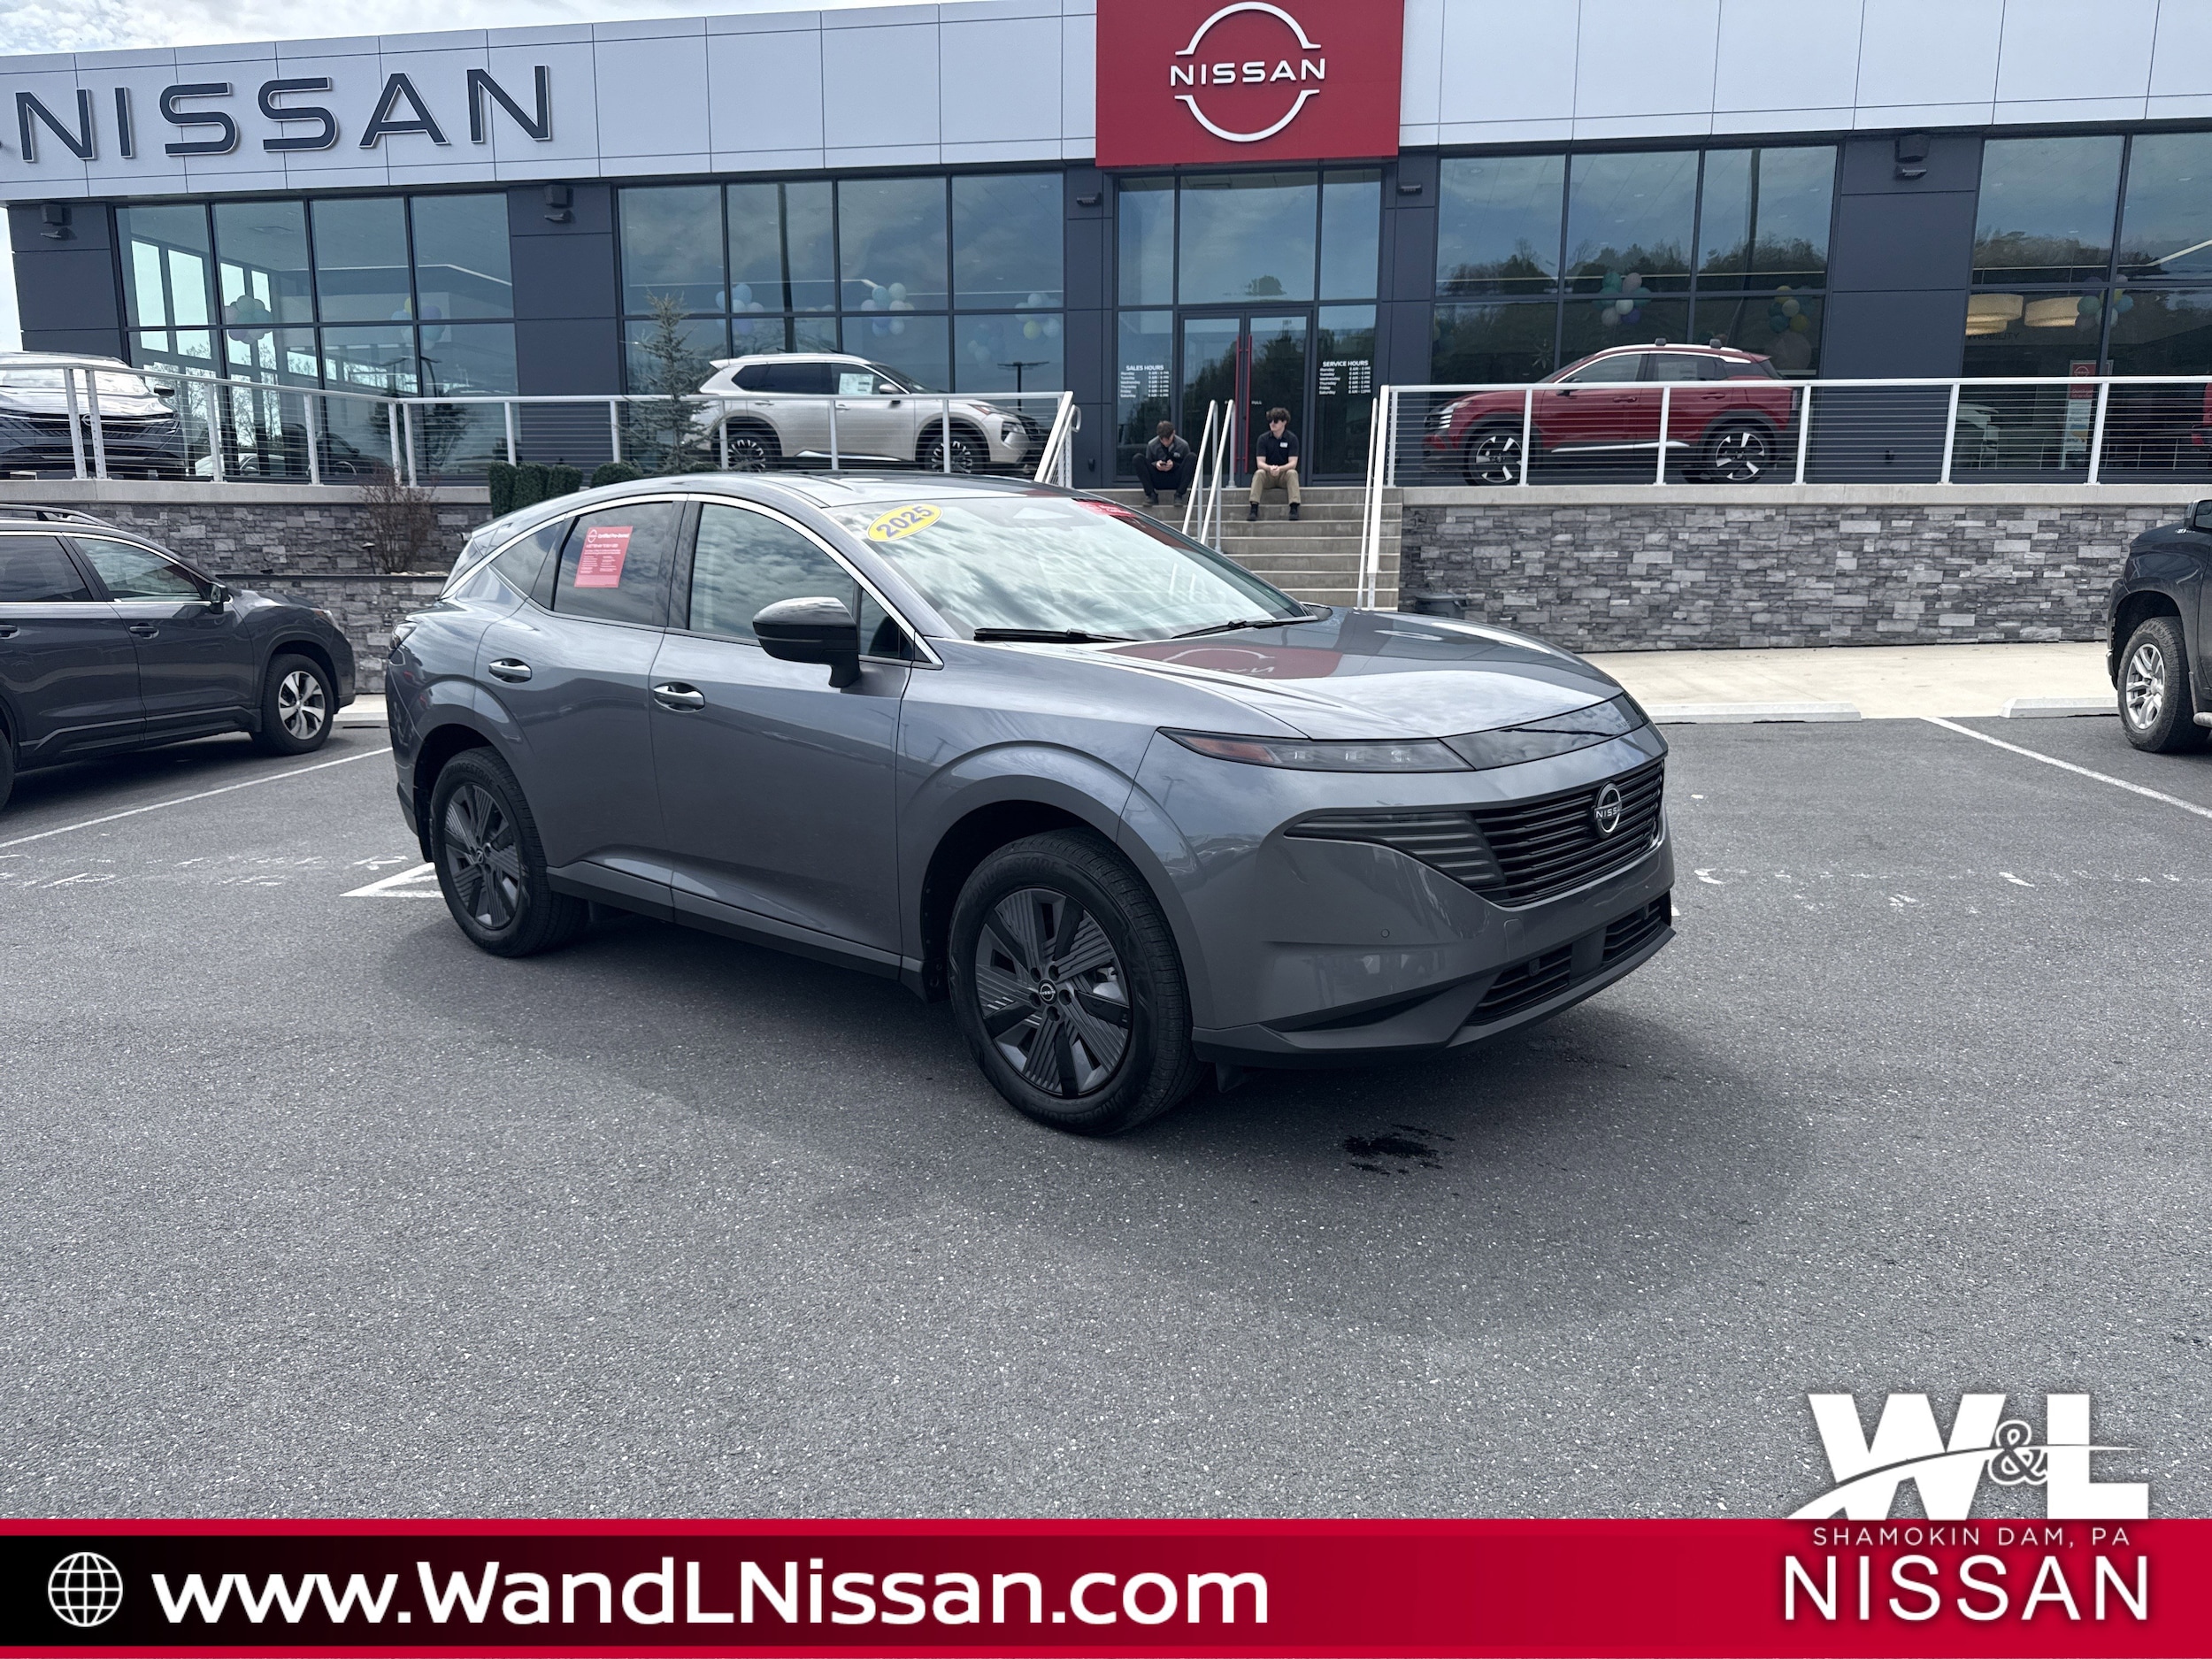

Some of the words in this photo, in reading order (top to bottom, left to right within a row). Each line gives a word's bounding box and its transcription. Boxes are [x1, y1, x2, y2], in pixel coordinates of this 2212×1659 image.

[1170, 58, 1326, 87] NISSAN
[15, 65, 552, 163] NISSAN
[876, 505, 933, 538] 2025
